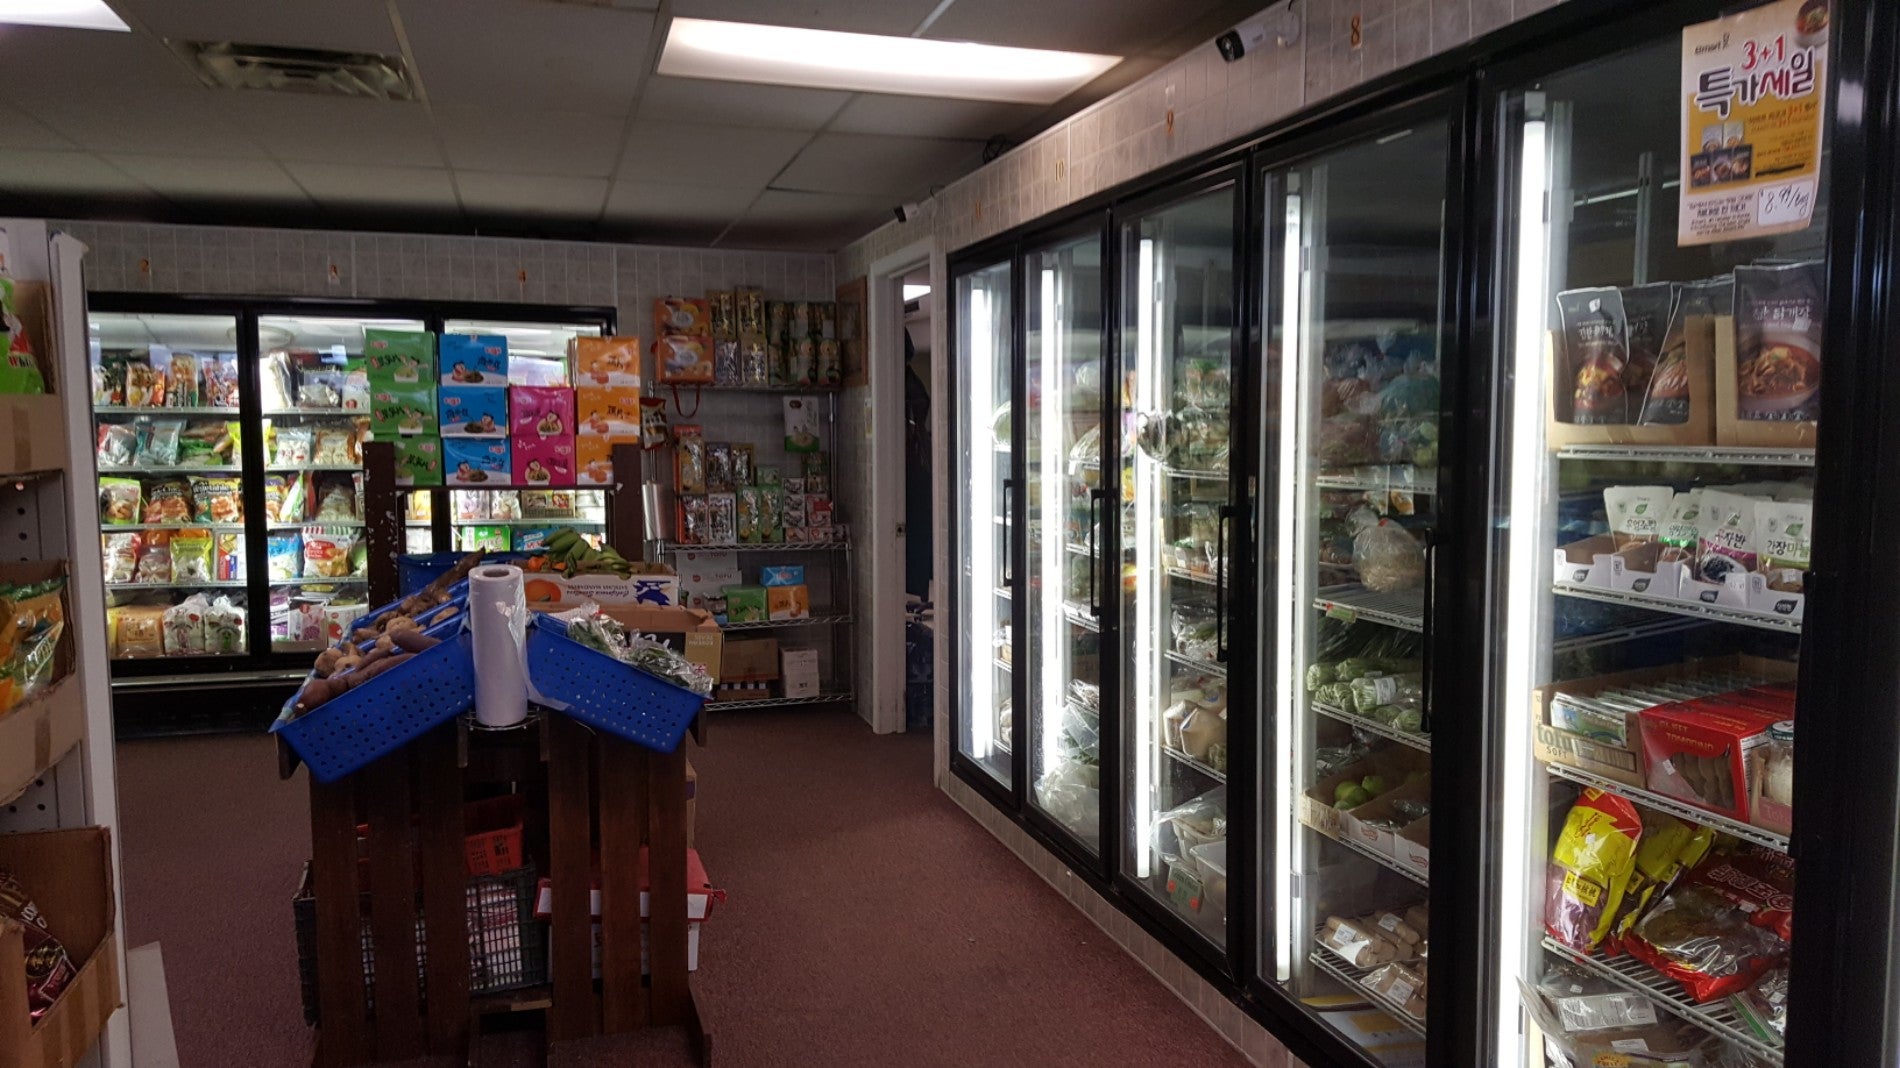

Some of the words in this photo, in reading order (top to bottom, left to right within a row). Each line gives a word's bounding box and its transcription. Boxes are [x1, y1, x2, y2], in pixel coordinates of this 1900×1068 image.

[1350, 14, 1361, 47] 8
[1741, 35, 1785, 71] 3+1
[1695, 49, 1814, 117] 특가세일
[1166, 109, 1175, 136] 9
[1055, 160, 1065, 182] 10
